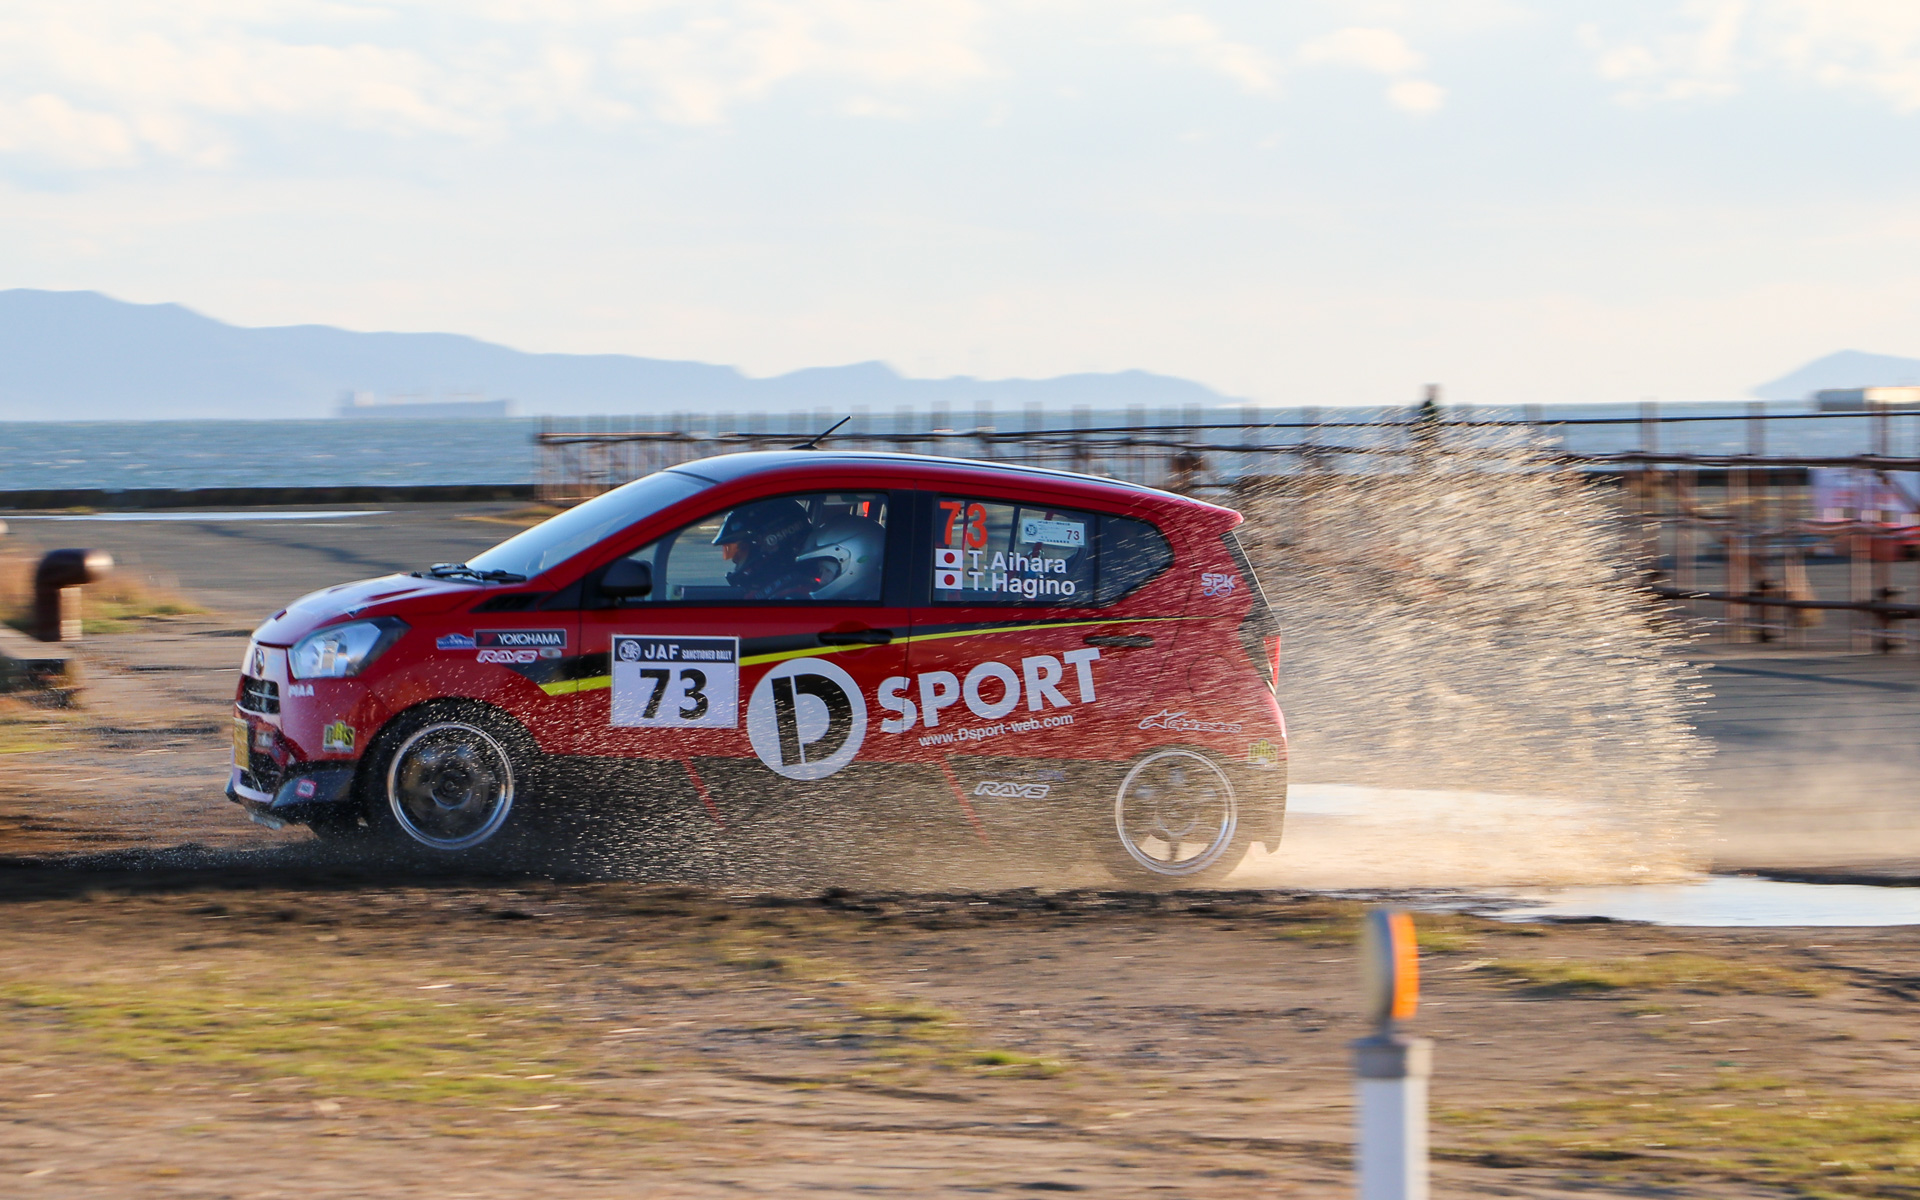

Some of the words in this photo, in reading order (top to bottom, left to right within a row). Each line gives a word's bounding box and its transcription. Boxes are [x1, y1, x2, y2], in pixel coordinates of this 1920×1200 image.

[939, 501, 988, 548] 73
[1066, 530, 1080, 541] 73
[967, 550, 1067, 574] T.Aihara
[967, 571, 1076, 599] T.Hagino
[1201, 572, 1237, 589] SPK
[497, 632, 562, 645] YOKOHAMA
[476, 650, 538, 663] RAYS
[644, 643, 680, 660] JAF
[640, 668, 709, 720] 73
[771, 672, 853, 767] D
[877, 647, 1101, 734] SPORT
[918, 713, 1075, 747] www.Dsport-web.com
[974, 781, 1050, 799] RAYS
